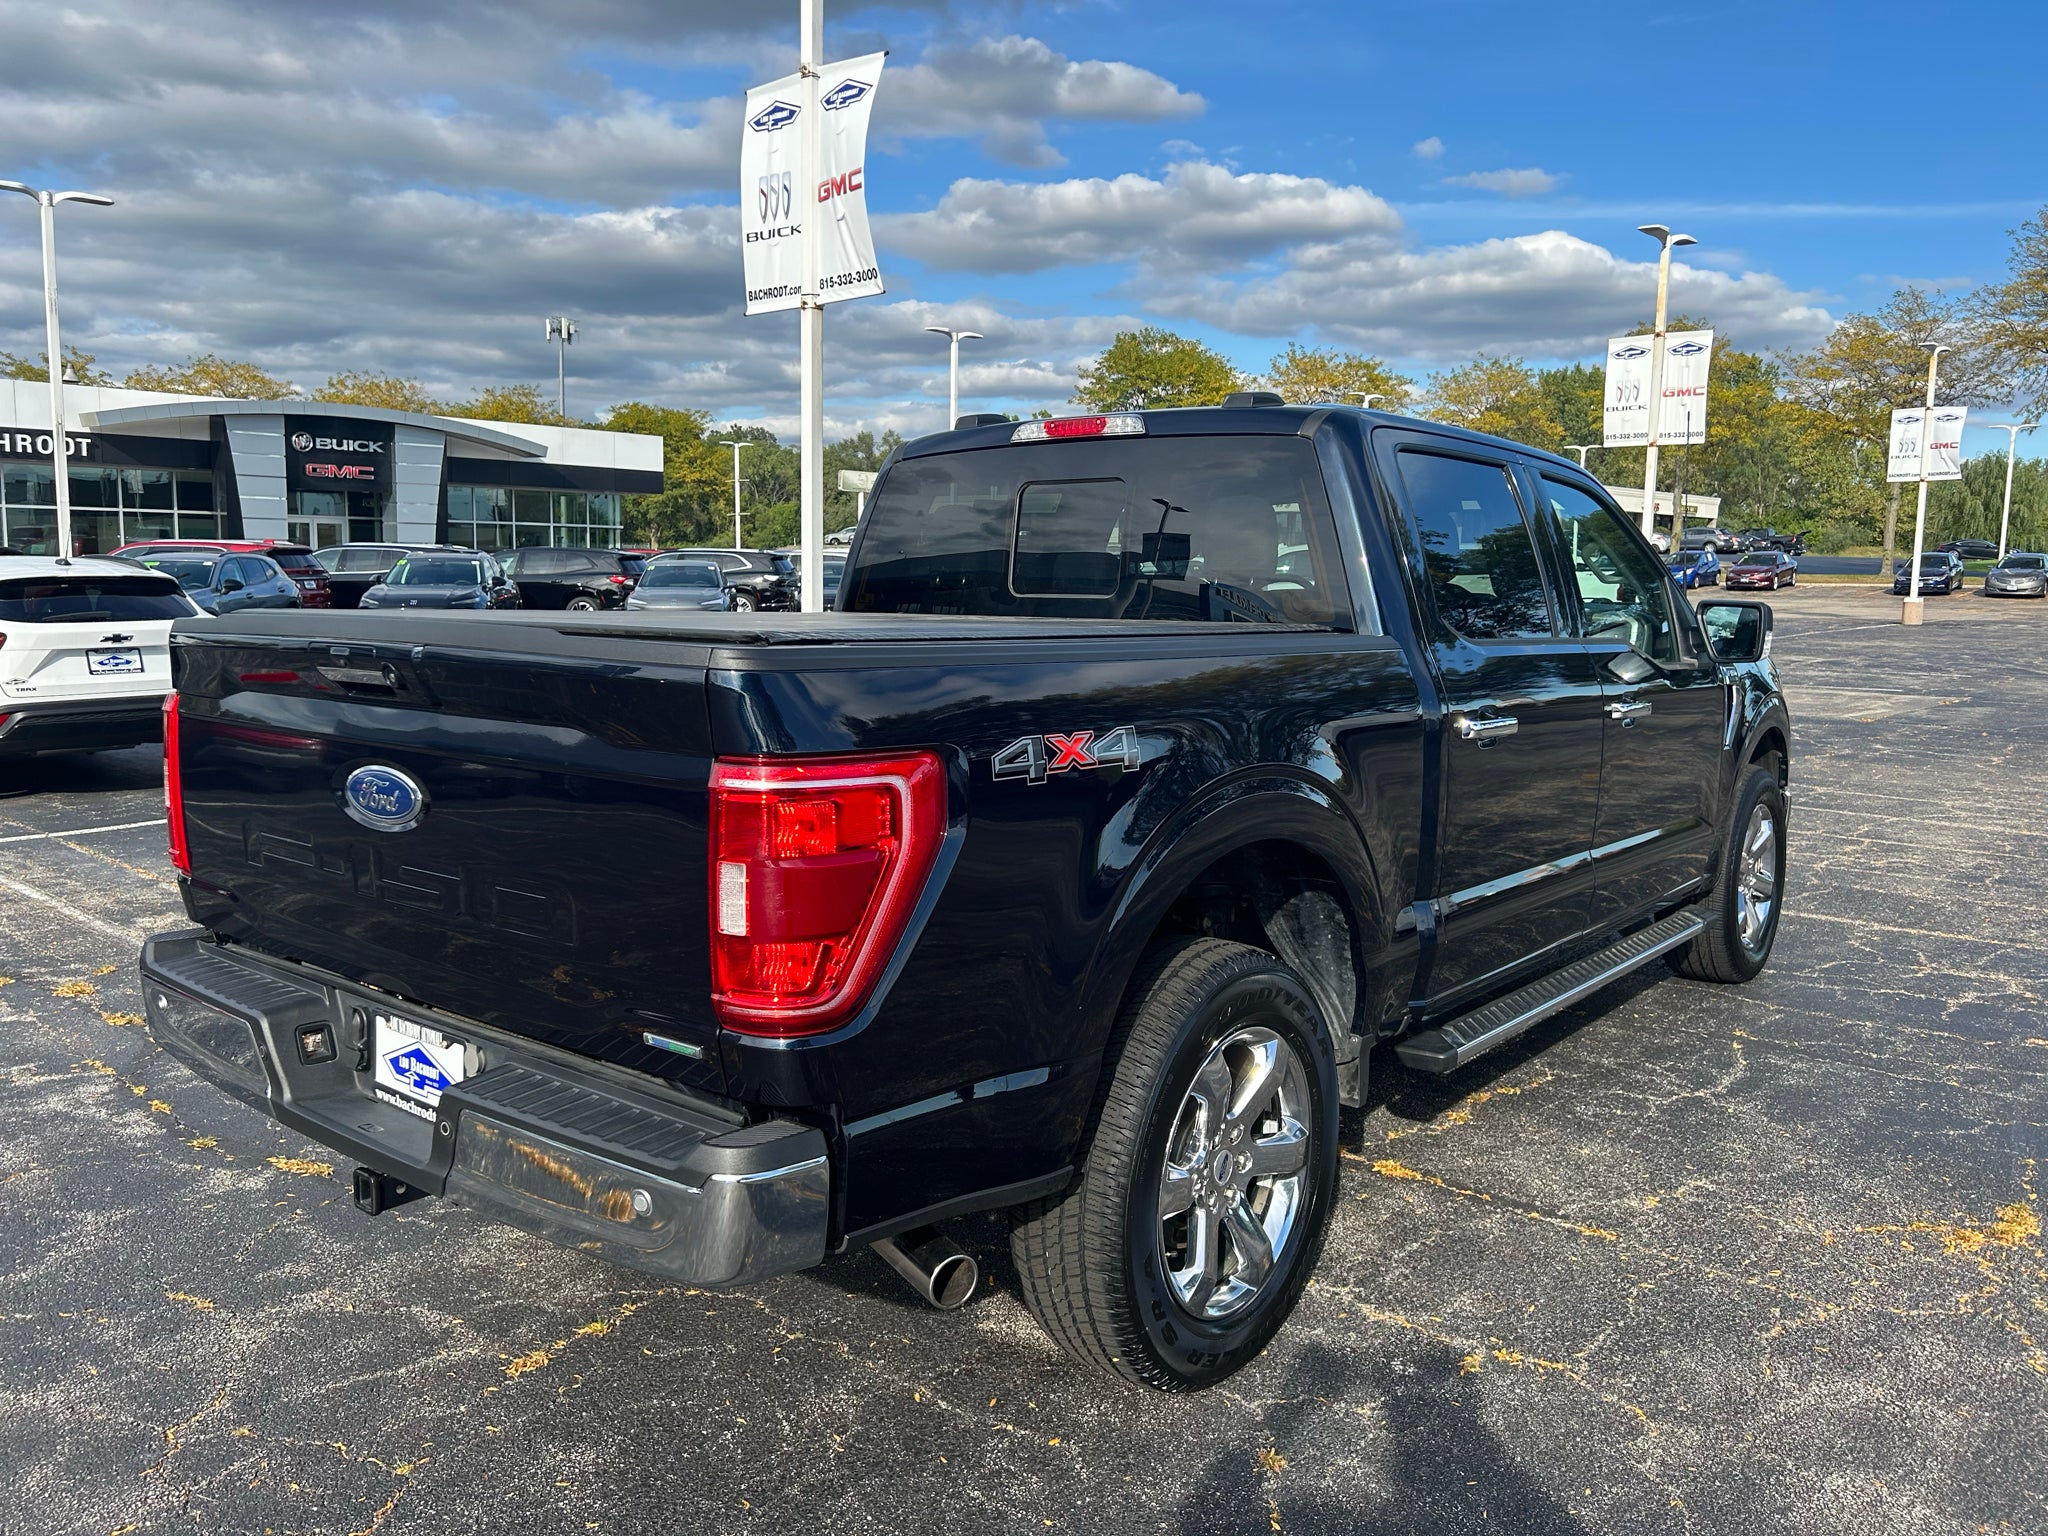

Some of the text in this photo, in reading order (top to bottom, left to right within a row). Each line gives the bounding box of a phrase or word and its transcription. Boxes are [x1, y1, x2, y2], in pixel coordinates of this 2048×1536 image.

[818, 167, 862, 203] GMC
[746, 224, 801, 243] BUICK
[819, 267, 878, 290] 815-332-3000
[1662, 386, 1705, 398] GMC
[1606, 404, 1648, 412] BUICK
[1605, 432, 1649, 440] 815-332-3000
[315, 437, 385, 453] BUICK
[305, 463, 374, 480] GMC
[360, 777, 400, 812] Ford
